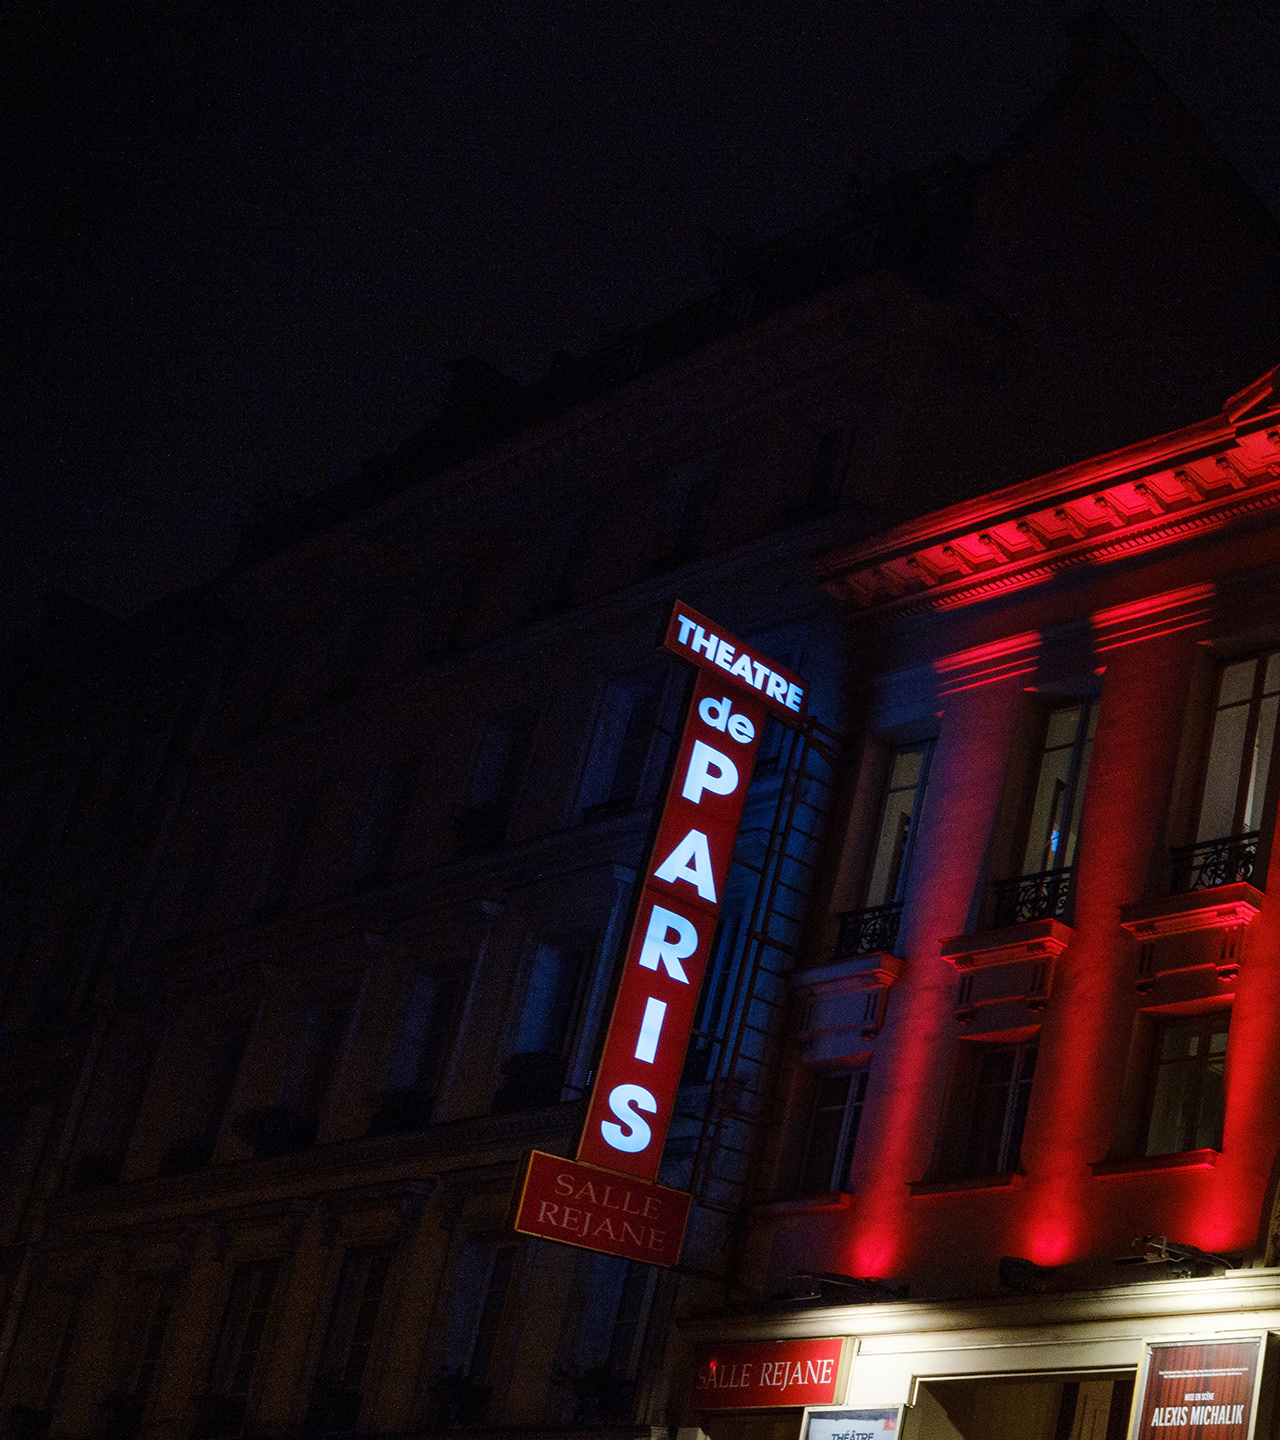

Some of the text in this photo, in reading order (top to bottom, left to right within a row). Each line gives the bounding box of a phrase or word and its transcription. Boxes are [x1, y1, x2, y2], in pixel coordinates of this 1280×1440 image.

[676, 613, 803, 714] THEATRE
[699, 695, 755, 744] de
[601, 740, 739, 1154] PARIS
[555, 1172, 663, 1221] SALLE
[536, 1200, 666, 1255] REJANE
[696, 1359, 834, 1392] SALLE REJANE
[1151, 1404, 1244, 1427] ALEXIS MICHALIK
